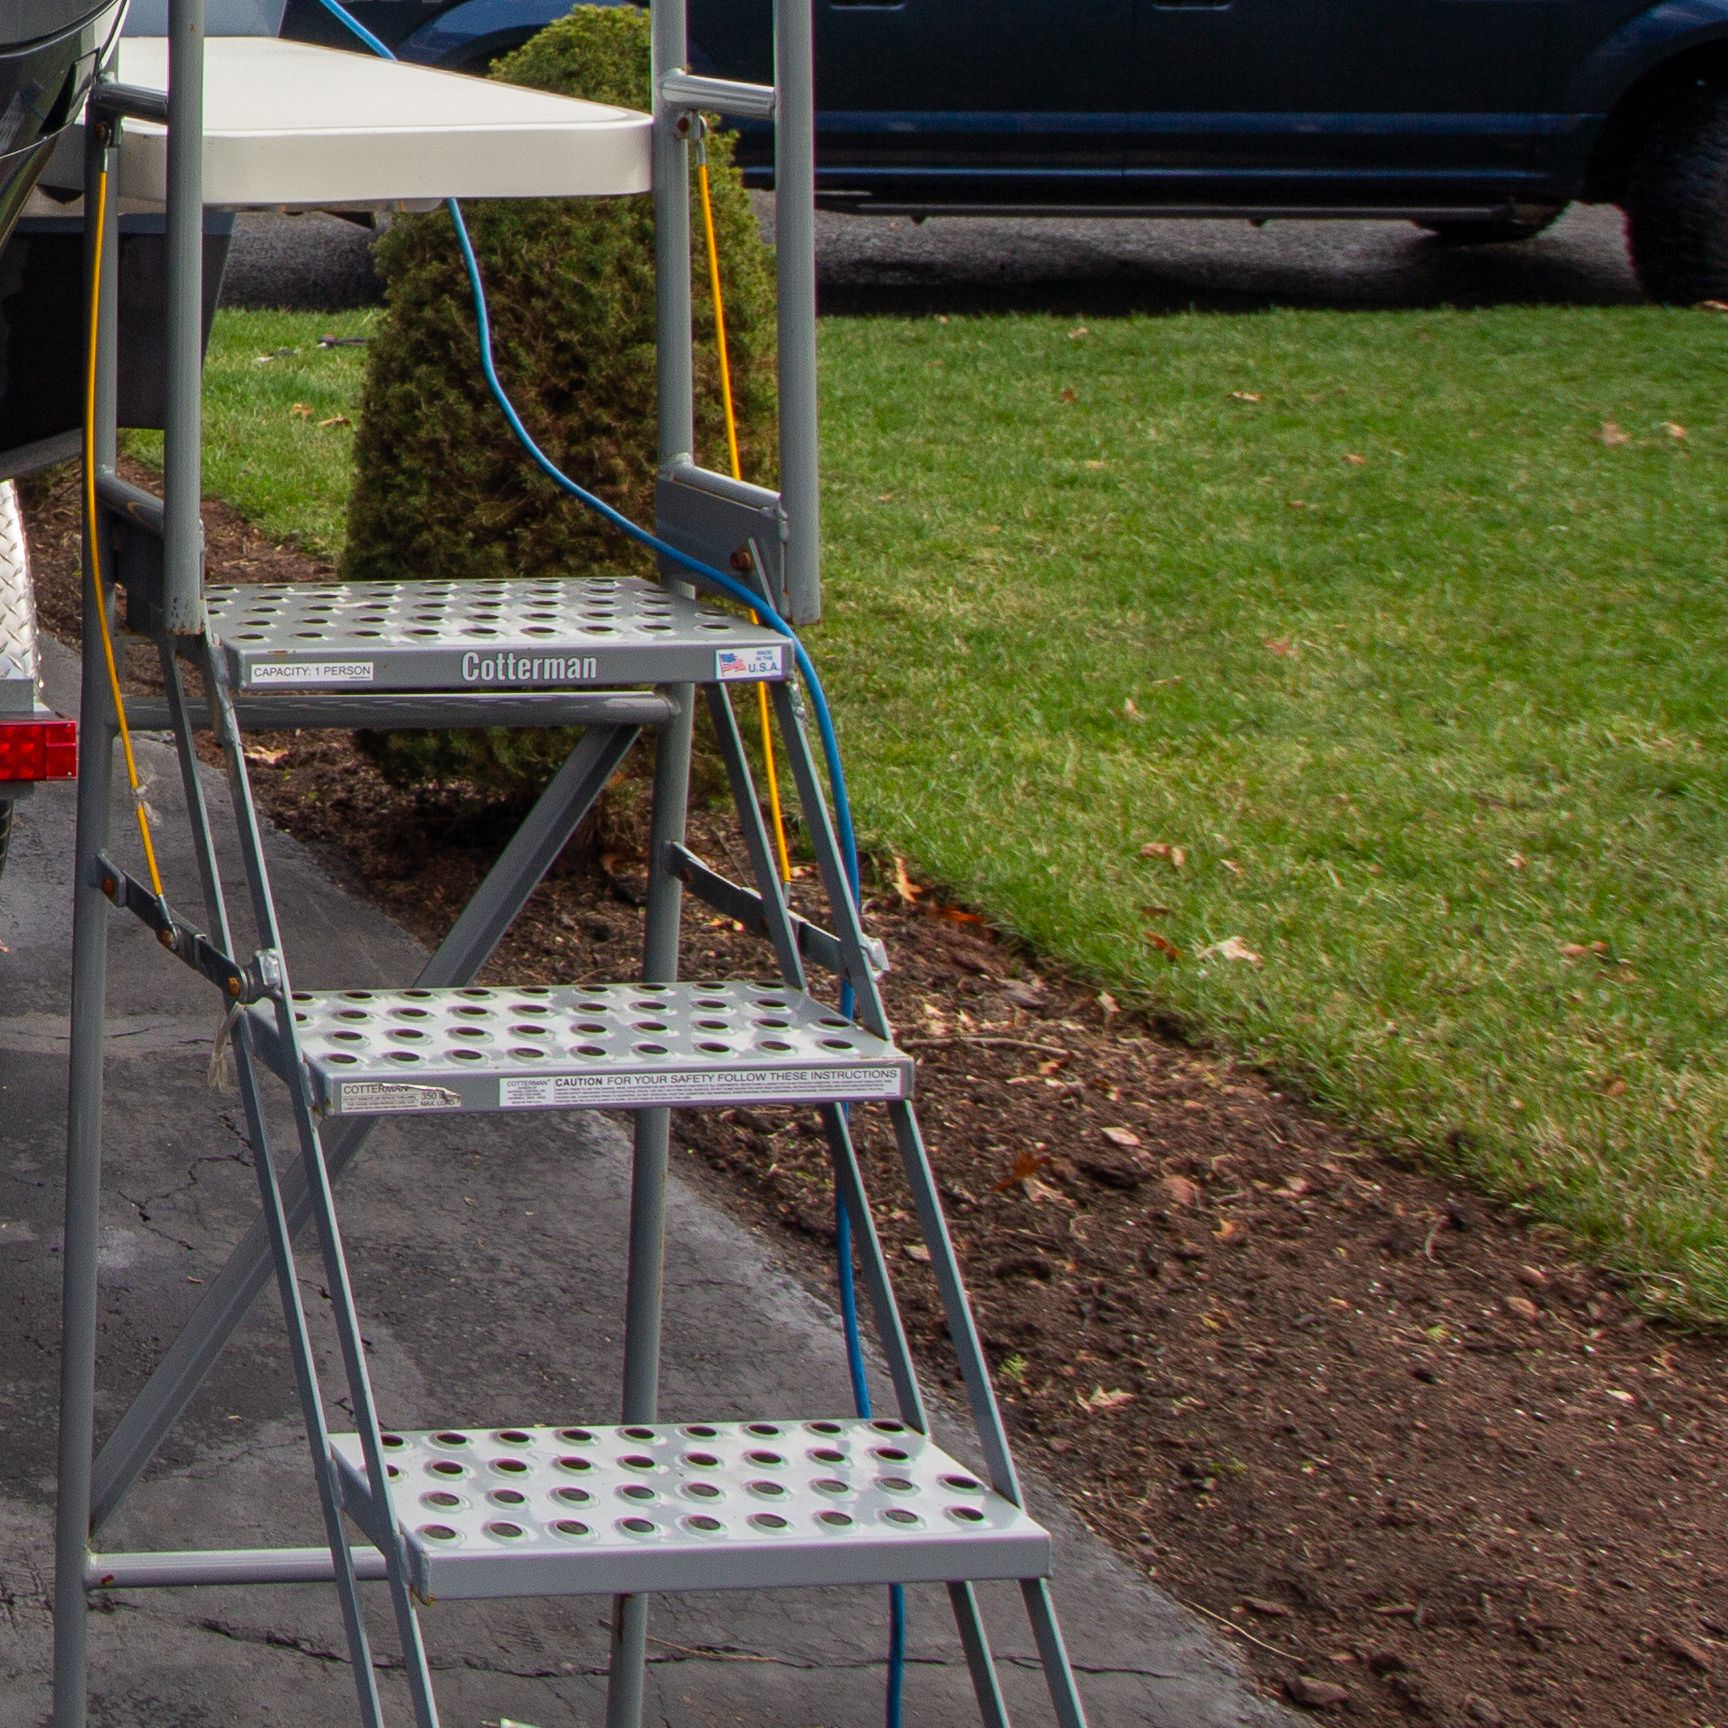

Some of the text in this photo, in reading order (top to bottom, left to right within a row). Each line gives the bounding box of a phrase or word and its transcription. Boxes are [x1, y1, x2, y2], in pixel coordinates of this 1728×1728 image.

[253, 666, 311, 677] CAPACITY:
[324, 665, 371, 676] PERSON
[462, 651, 597, 681] Cotterman
[555, 1069, 897, 1087] CAUTION FOR YOUR SAFETY FOLLOW THESE INSTRUCTIONS
